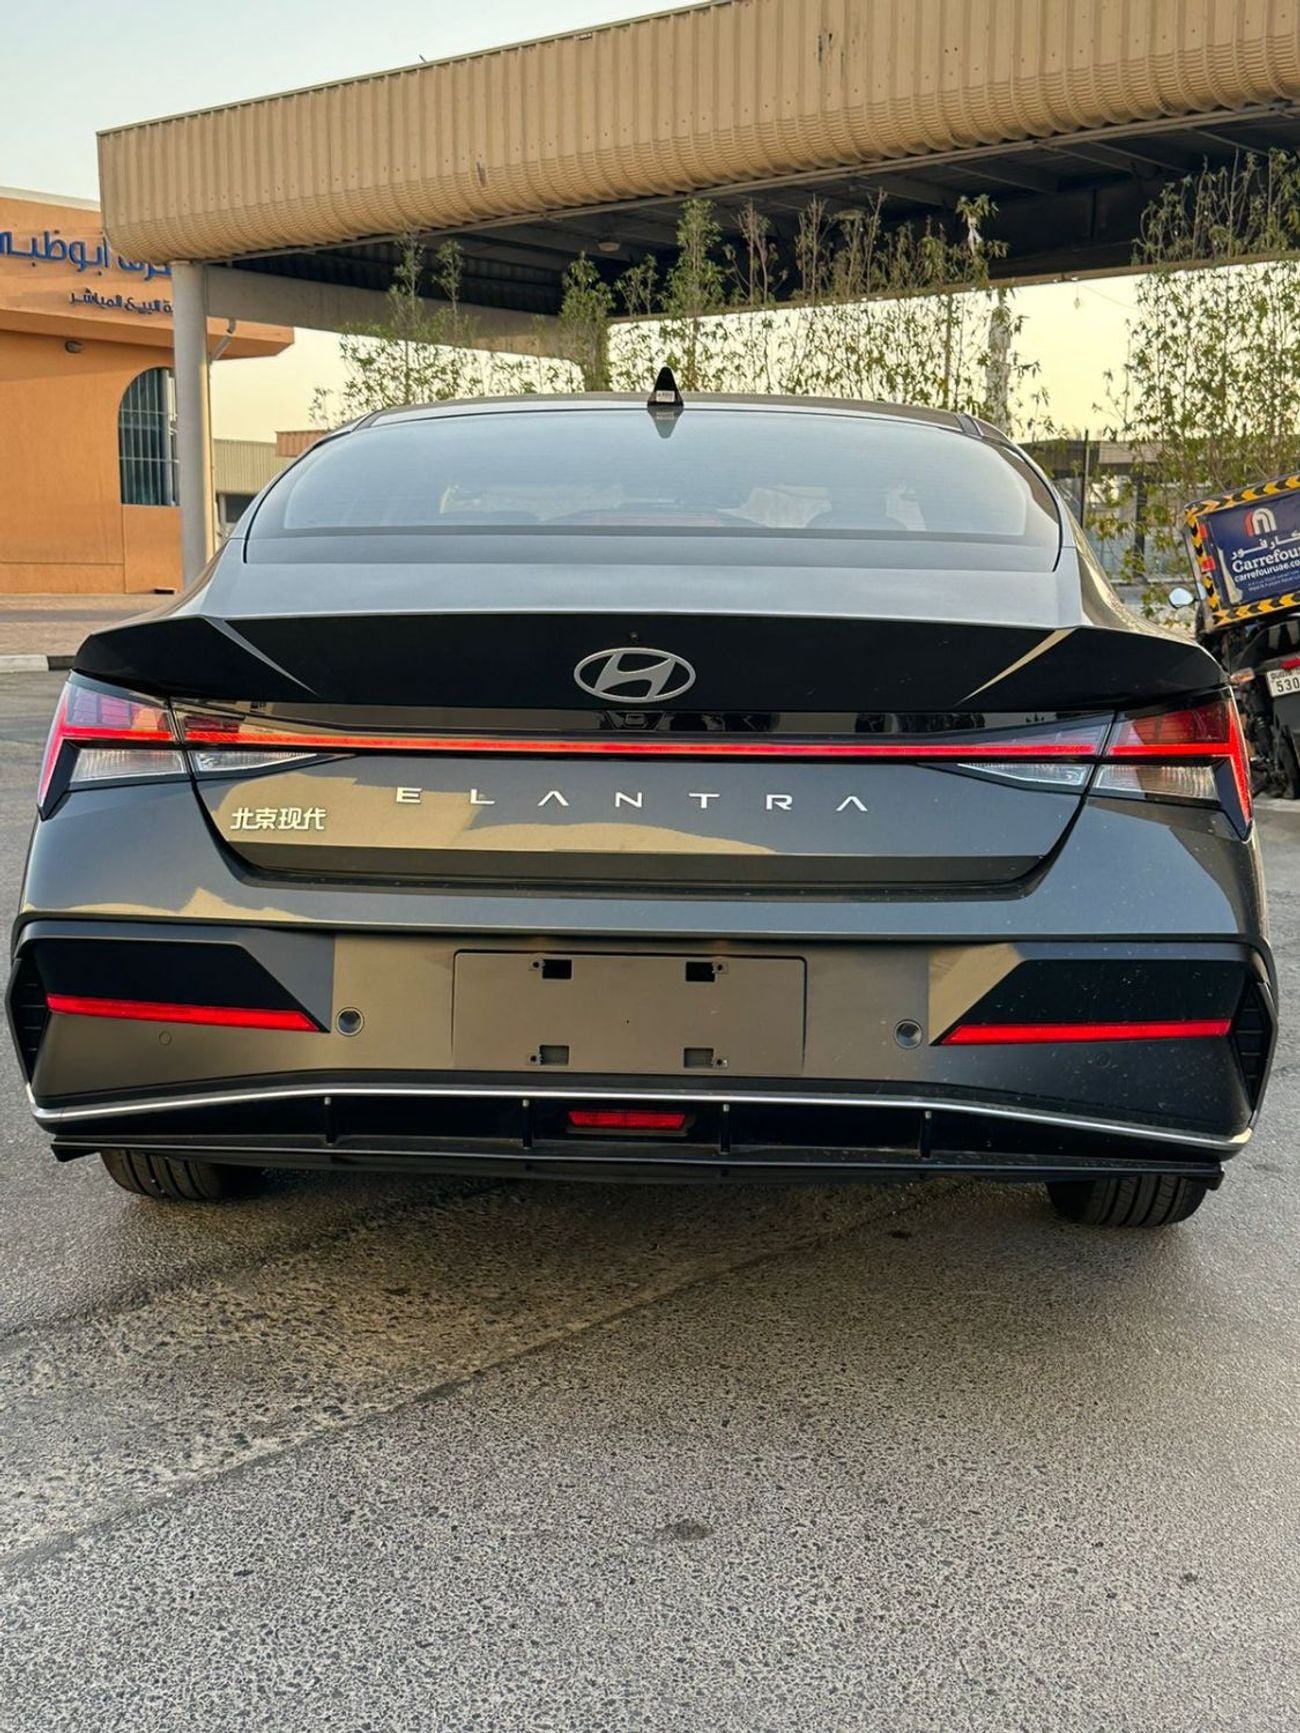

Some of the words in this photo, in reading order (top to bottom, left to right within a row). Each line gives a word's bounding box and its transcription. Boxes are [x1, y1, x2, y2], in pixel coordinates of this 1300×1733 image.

[69, 288, 122, 309] المباشر
[1232, 547, 1300, 573] Carrefou
[395, 786, 868, 812] ELANTRA
[229, 806, 327, 830] 北京现代
